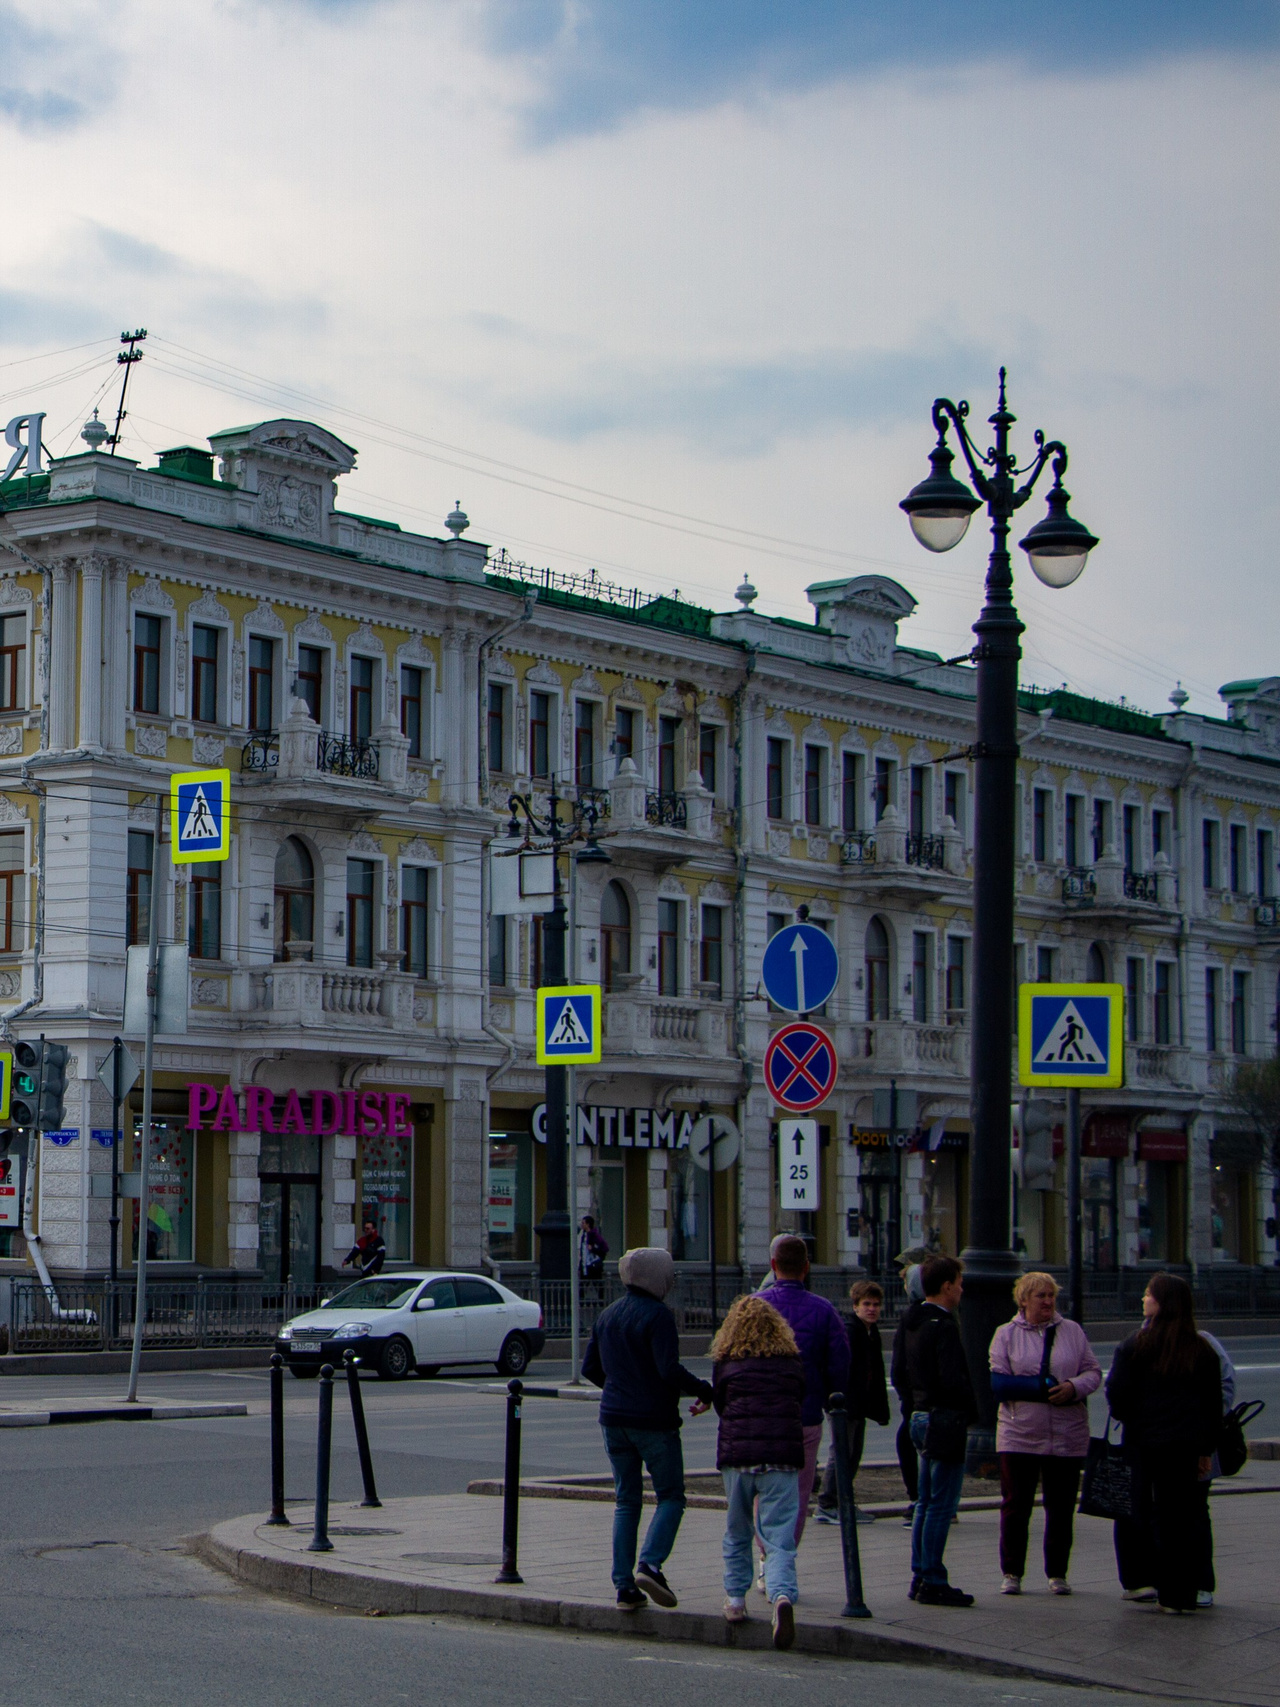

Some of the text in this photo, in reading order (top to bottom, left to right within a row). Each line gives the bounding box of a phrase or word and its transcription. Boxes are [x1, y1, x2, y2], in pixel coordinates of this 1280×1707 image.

[184, 1082, 414, 1137] PARADISE
[530, 1102, 705, 1150] GNTLEMA
[58, 1137, 63, 1145] 2
[789, 1164, 809, 1180] 25
[491, 1185, 510, 1196] SALE
[793, 1188, 805, 1199] М
